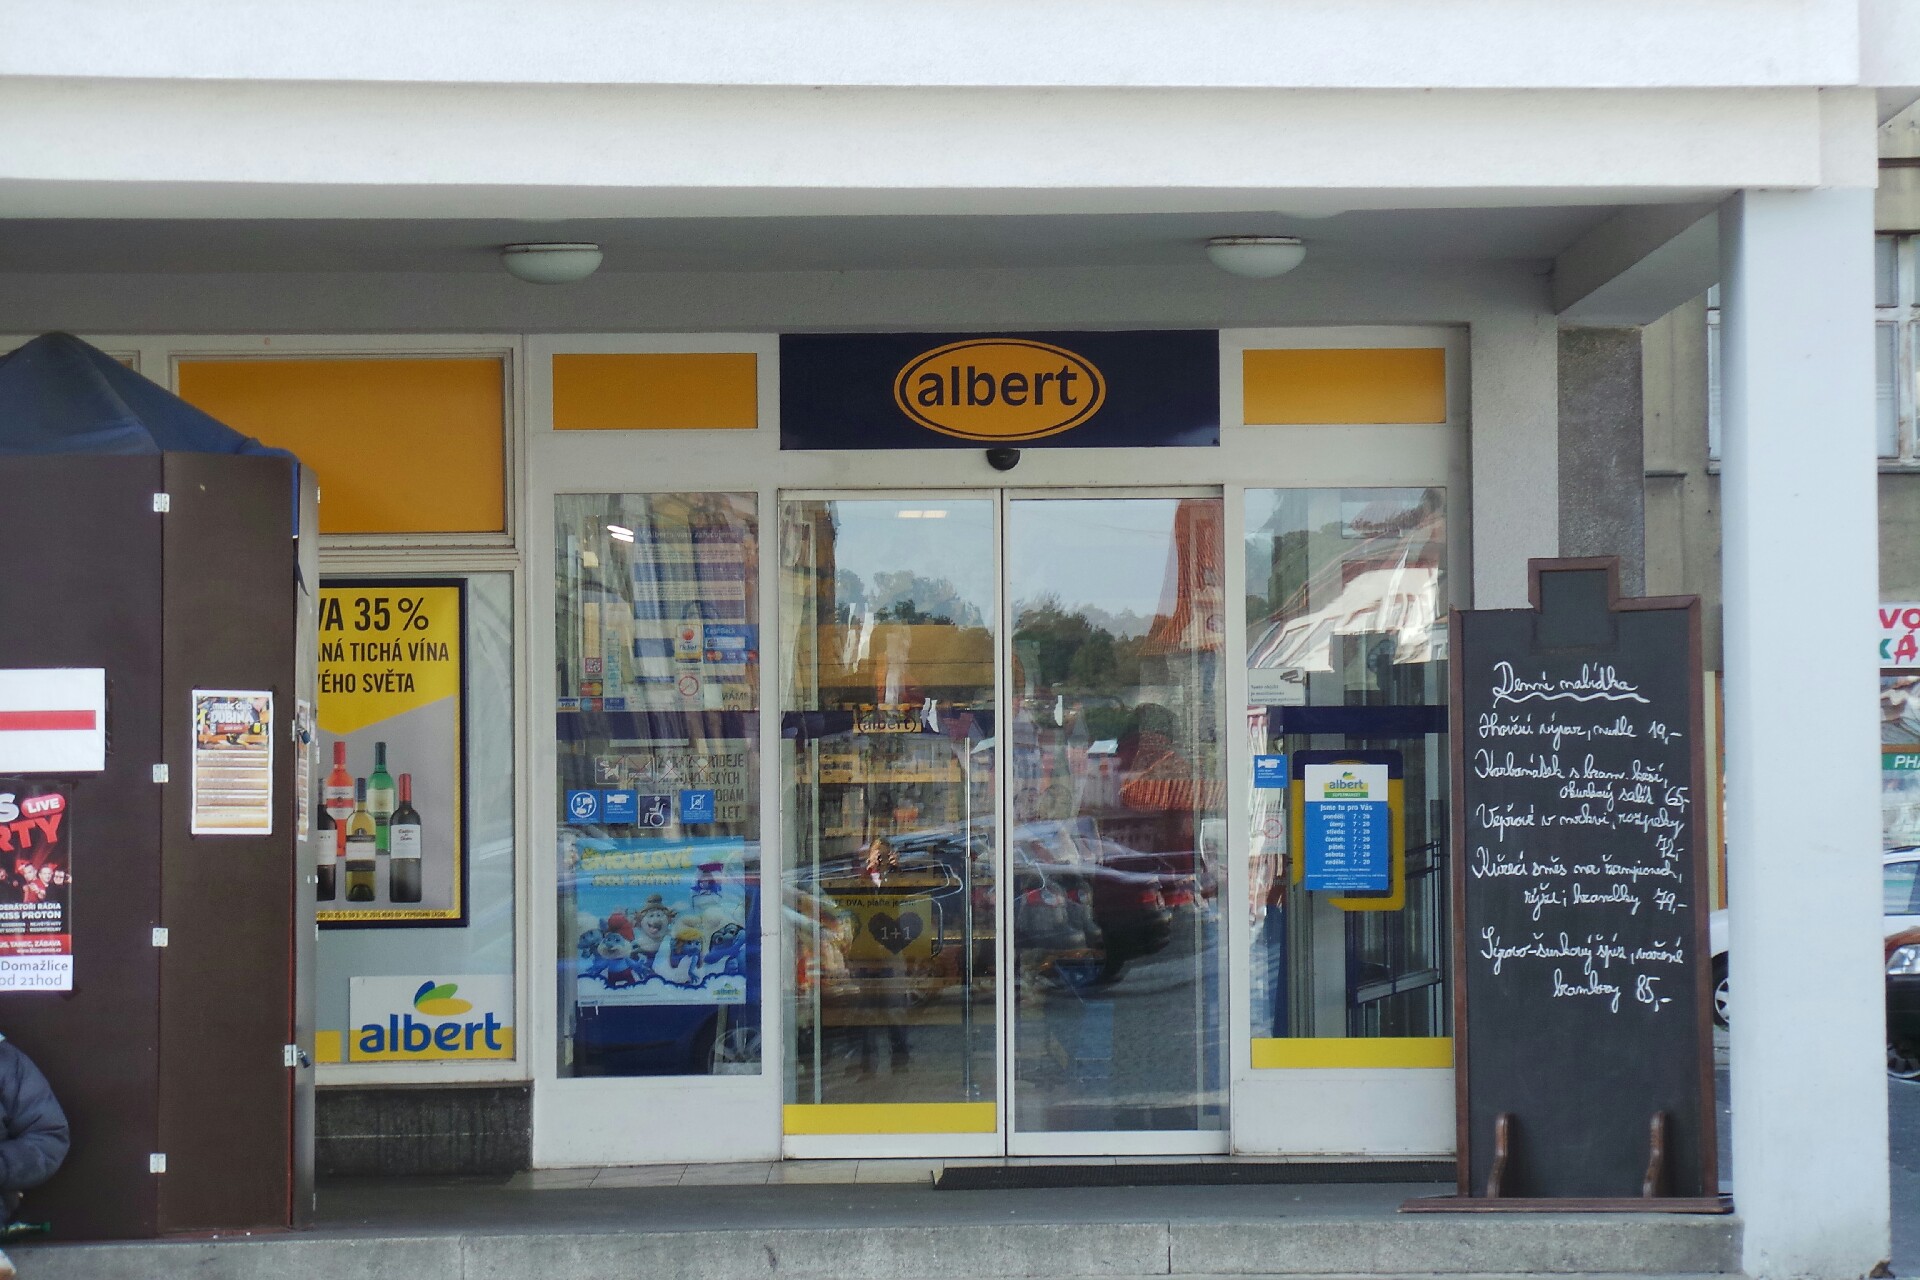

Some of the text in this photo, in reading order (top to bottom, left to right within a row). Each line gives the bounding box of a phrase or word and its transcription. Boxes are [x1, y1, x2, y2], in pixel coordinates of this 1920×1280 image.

[917, 365, 1078, 407] albert
[354, 597, 391, 631] 35
[398, 597, 429, 631] %
[318, 637, 449, 662] NÁ TICHÁ VÍNA
[317, 668, 415, 693] ÉHO SVĚTA
[1493, 661, 1638, 697] Denní nabídka
[1569, 767, 1580, 779] s
[1329, 779, 1364, 790] albert
[26, 797, 60, 814] LIVE
[1320, 804, 1336, 812] Jsme
[37, 901, 61, 910] RÁDIA
[21, 910, 61, 919] PROTON
[881, 926, 911, 940] 1+1
[34, 939, 62, 947] ZÁBAVA
[1, 960, 68, 971] Domažlice
[0, 974, 62, 986] od 21hod
[359, 1011, 502, 1053] albert
